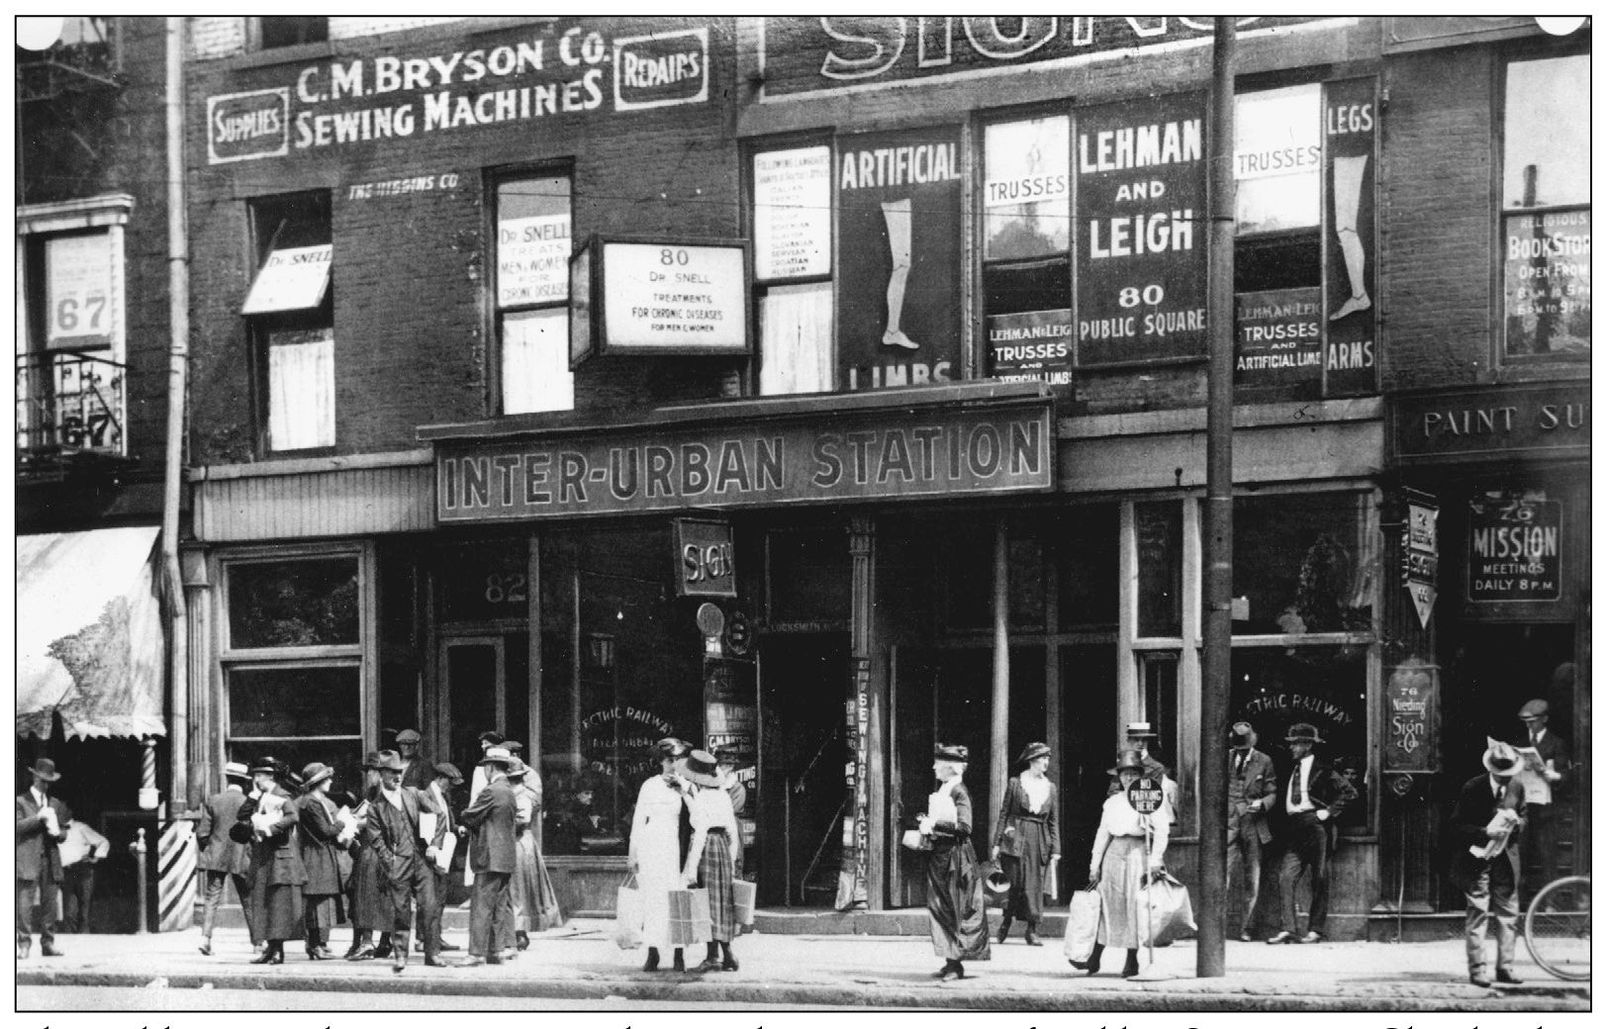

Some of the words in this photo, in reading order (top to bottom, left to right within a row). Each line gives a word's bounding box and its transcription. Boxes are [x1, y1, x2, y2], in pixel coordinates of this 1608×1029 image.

[559, 27, 611, 66] CO.
[623, 51, 701, 88] REPAIRS
[294, 103, 415, 149] SEWING
[423, 69, 602, 132] MACHINES
[1327, 103, 1374, 135] LEGS
[215, 107, 282, 143] SUPPLIES
[1079, 118, 1202, 174] LEHMAN
[841, 142, 963, 190] ARTIFICIAL
[1238, 144, 1321, 175] TRUSSES
[990, 175, 1066, 202] TRUSSES
[1115, 180, 1166, 202] AND
[523, 222, 571, 243] SNELL
[1089, 208, 1193, 259] LEIGH
[289, 250, 332, 266] SNELL
[660, 249, 689, 266] 80
[675, 272, 712, 284] SNELL
[1519, 265, 1551, 280] OPEN
[1554, 262, 1588, 277] FROM
[653, 293, 713, 304] TREATMENTS
[1118, 284, 1165, 308] 80
[56, 296, 107, 332] 67
[632, 307, 649, 318] FOR
[652, 307, 683, 319] CHRONIC
[686, 309, 724, 321] DISEASES
[1237, 302, 1292, 321] LEHMAN
[651, 323, 665, 331] FOR
[666, 324, 681, 332] MEN
[689, 324, 715, 332] WOMEN
[990, 326, 1041, 341] LEHMAN
[1079, 316, 1136, 341] PUBLIC
[1143, 308, 1207, 337] SQUARE
[1244, 322, 1320, 341] TRUSSES
[994, 342, 1067, 361] TRUSSES
[1270, 341, 1297, 350] AND
[1327, 340, 1374, 371] ARMS
[1019, 361, 1043, 369] AND
[1236, 353, 1297, 371] ARTIFICIAL
[1423, 405, 1518, 438] PAINT
[1539, 403, 1584, 430] SU
[444, 436, 787, 511] INTER-URBAN
[812, 419, 1042, 488] STATION
[1473, 525, 1557, 559] MISSION
[683, 542, 732, 581] SIGN
[1482, 562, 1546, 575] MEETINGS
[485, 573, 527, 603] 82
[1474, 579, 1515, 591] DAILY
[1519, 579, 1529, 591] 8
[626, 706, 674, 735] RAILWAY
[1292, 693, 1353, 726] RAILWAY
[1392, 715, 1425, 753] Sign
[1130, 790, 1162, 801] PARKING
[1140, 778, 1152, 790] NO
[1136, 800, 1155, 811] HERE
